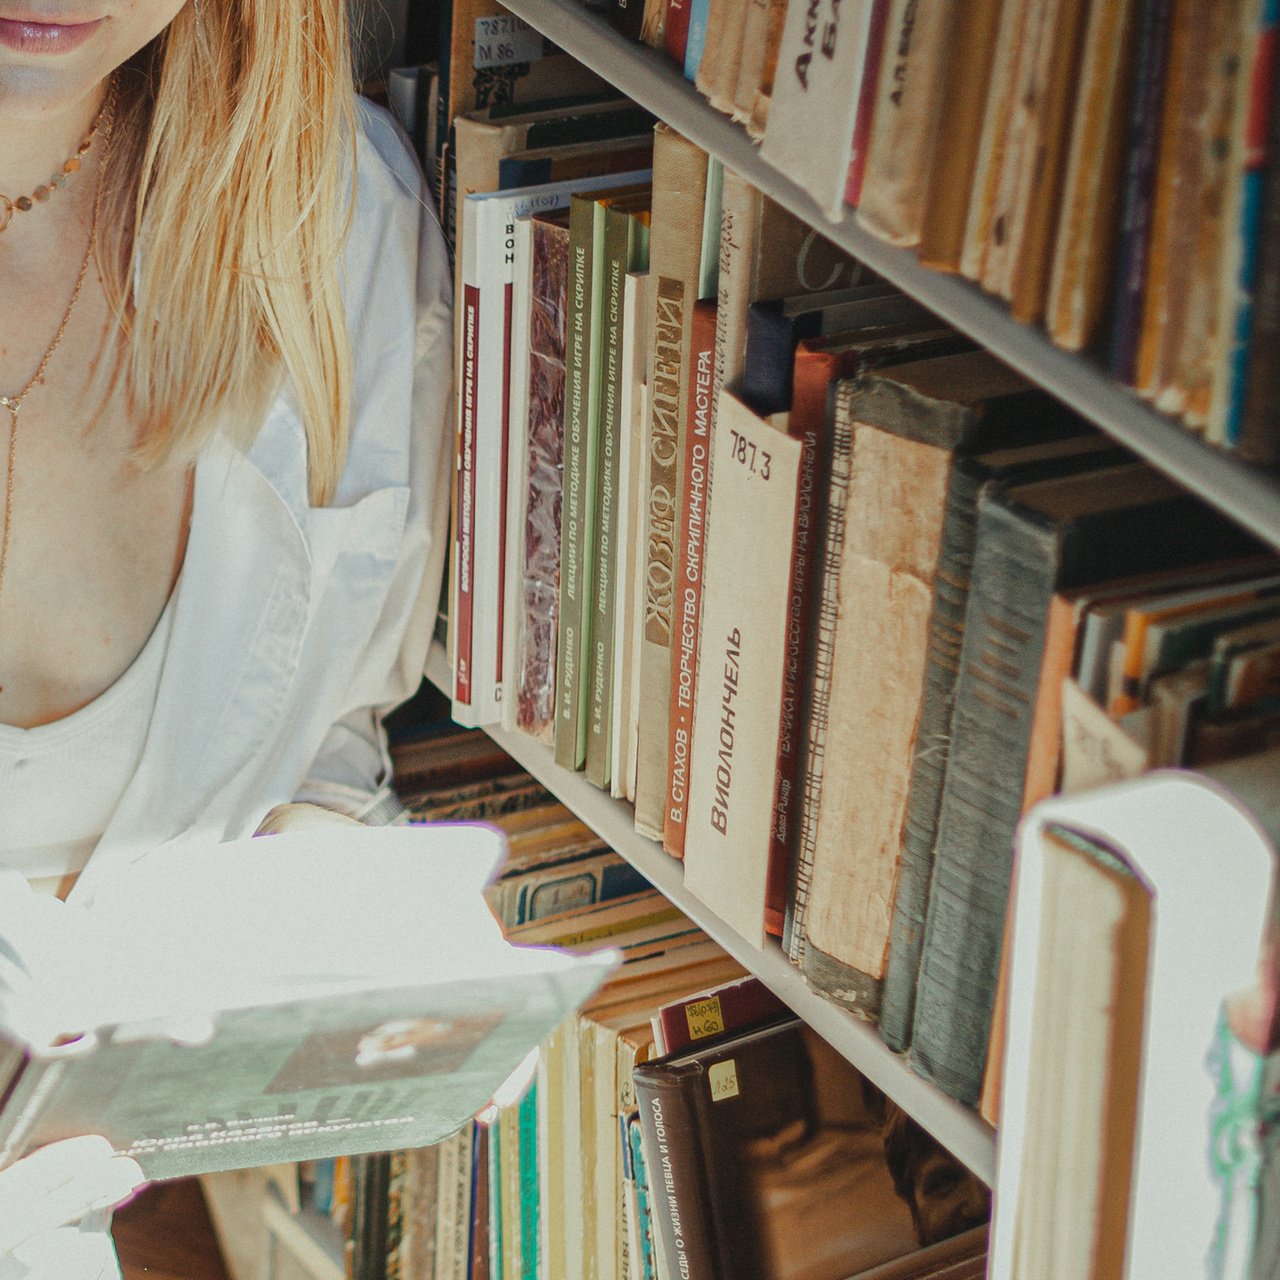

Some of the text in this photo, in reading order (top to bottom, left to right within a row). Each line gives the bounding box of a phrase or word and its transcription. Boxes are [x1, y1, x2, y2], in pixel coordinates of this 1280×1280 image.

[460, 306, 475, 593] ВОПРОСЫ МЕТОДИКИ ОБУЧЕНИЯ ИГРЕ НА СКРИПКЕ
[563, 245, 584, 718] В. И. РУДЕНКО ЛЕКЦИИ ПО МЕТОДИКЕ ОБУЧЕНИЯ ИГРЕ НА СКРИПКЕ
[592, 259, 620, 733] В. И. РУДЕНКО ЛЕКЦИИ ПО МЕТОДИКЕ ОБУЧЕНИЯ ИГРЕ НА СКРИПКЕ
[645, 295, 680, 631] ЖОЗЕФ СИГЕТИ
[730, 429, 771, 481] 787.3
[670, 349, 711, 823] В. СТАХОВ ТВОРЧЕСТВО СКРИПИЧНОГО МАСТЕРА
[778, 431, 816, 757] ТЕХНИКА И ИСКУССТВО ИГРЫ НА ВИОЛОНЧЕЛИ
[650, 1097, 667, 1142] ГОЛОСА
[658, 1143, 669, 1153] И
[660, 1155, 676, 1193] ПЕВЦА
[667, 1193, 683, 1237] ЖИЗНИ
[675, 1238, 685, 1248] О
